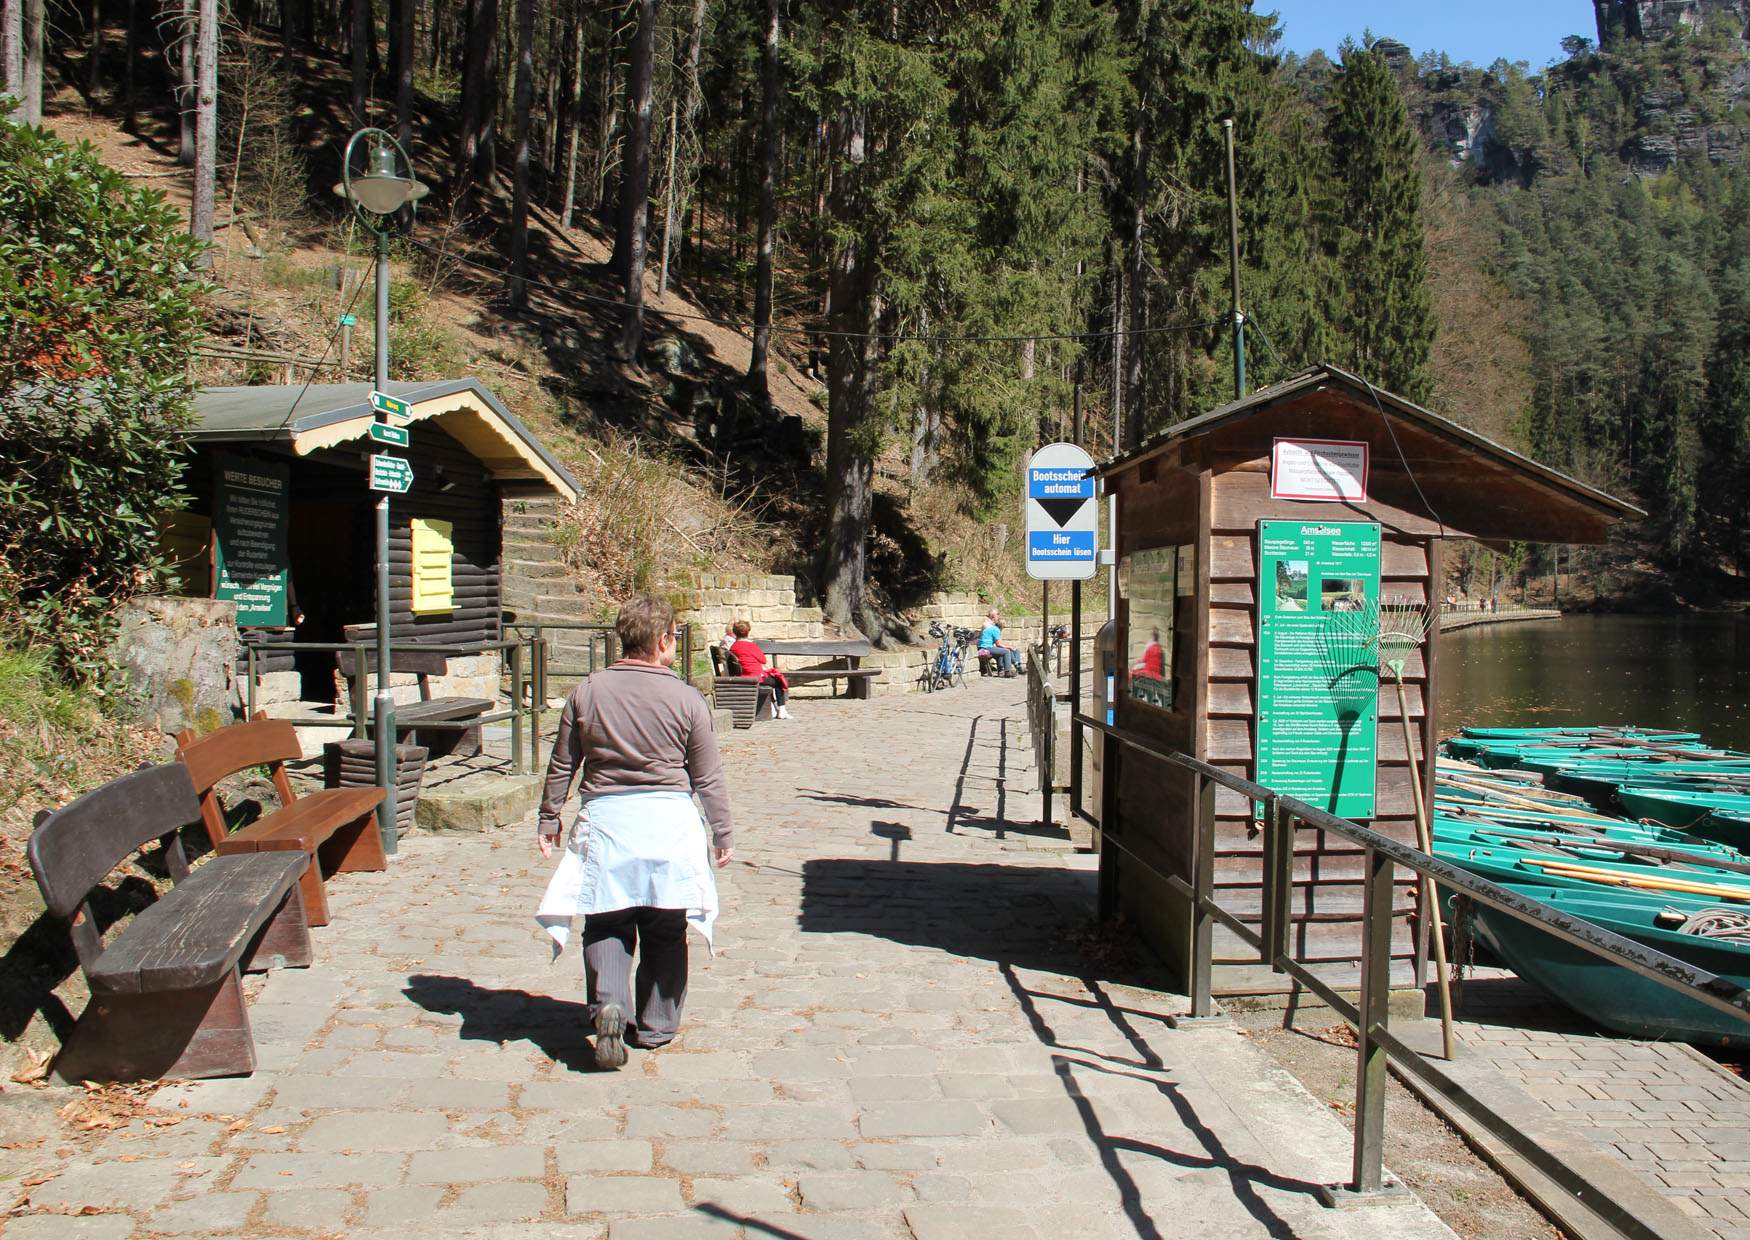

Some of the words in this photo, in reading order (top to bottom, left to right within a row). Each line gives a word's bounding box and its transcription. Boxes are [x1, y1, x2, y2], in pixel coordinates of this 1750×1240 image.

[224, 470, 248, 485] WERTE
[248, 473, 282, 489] BESUCHER
[1044, 484, 1081, 494] automat
[1301, 525, 1341, 535] Amselsee
[1053, 534, 1071, 545] Hier
[1032, 547, 1072, 556] Bootsschein
[1074, 547, 1092, 556] lösen
[233, 592, 242, 600] und
